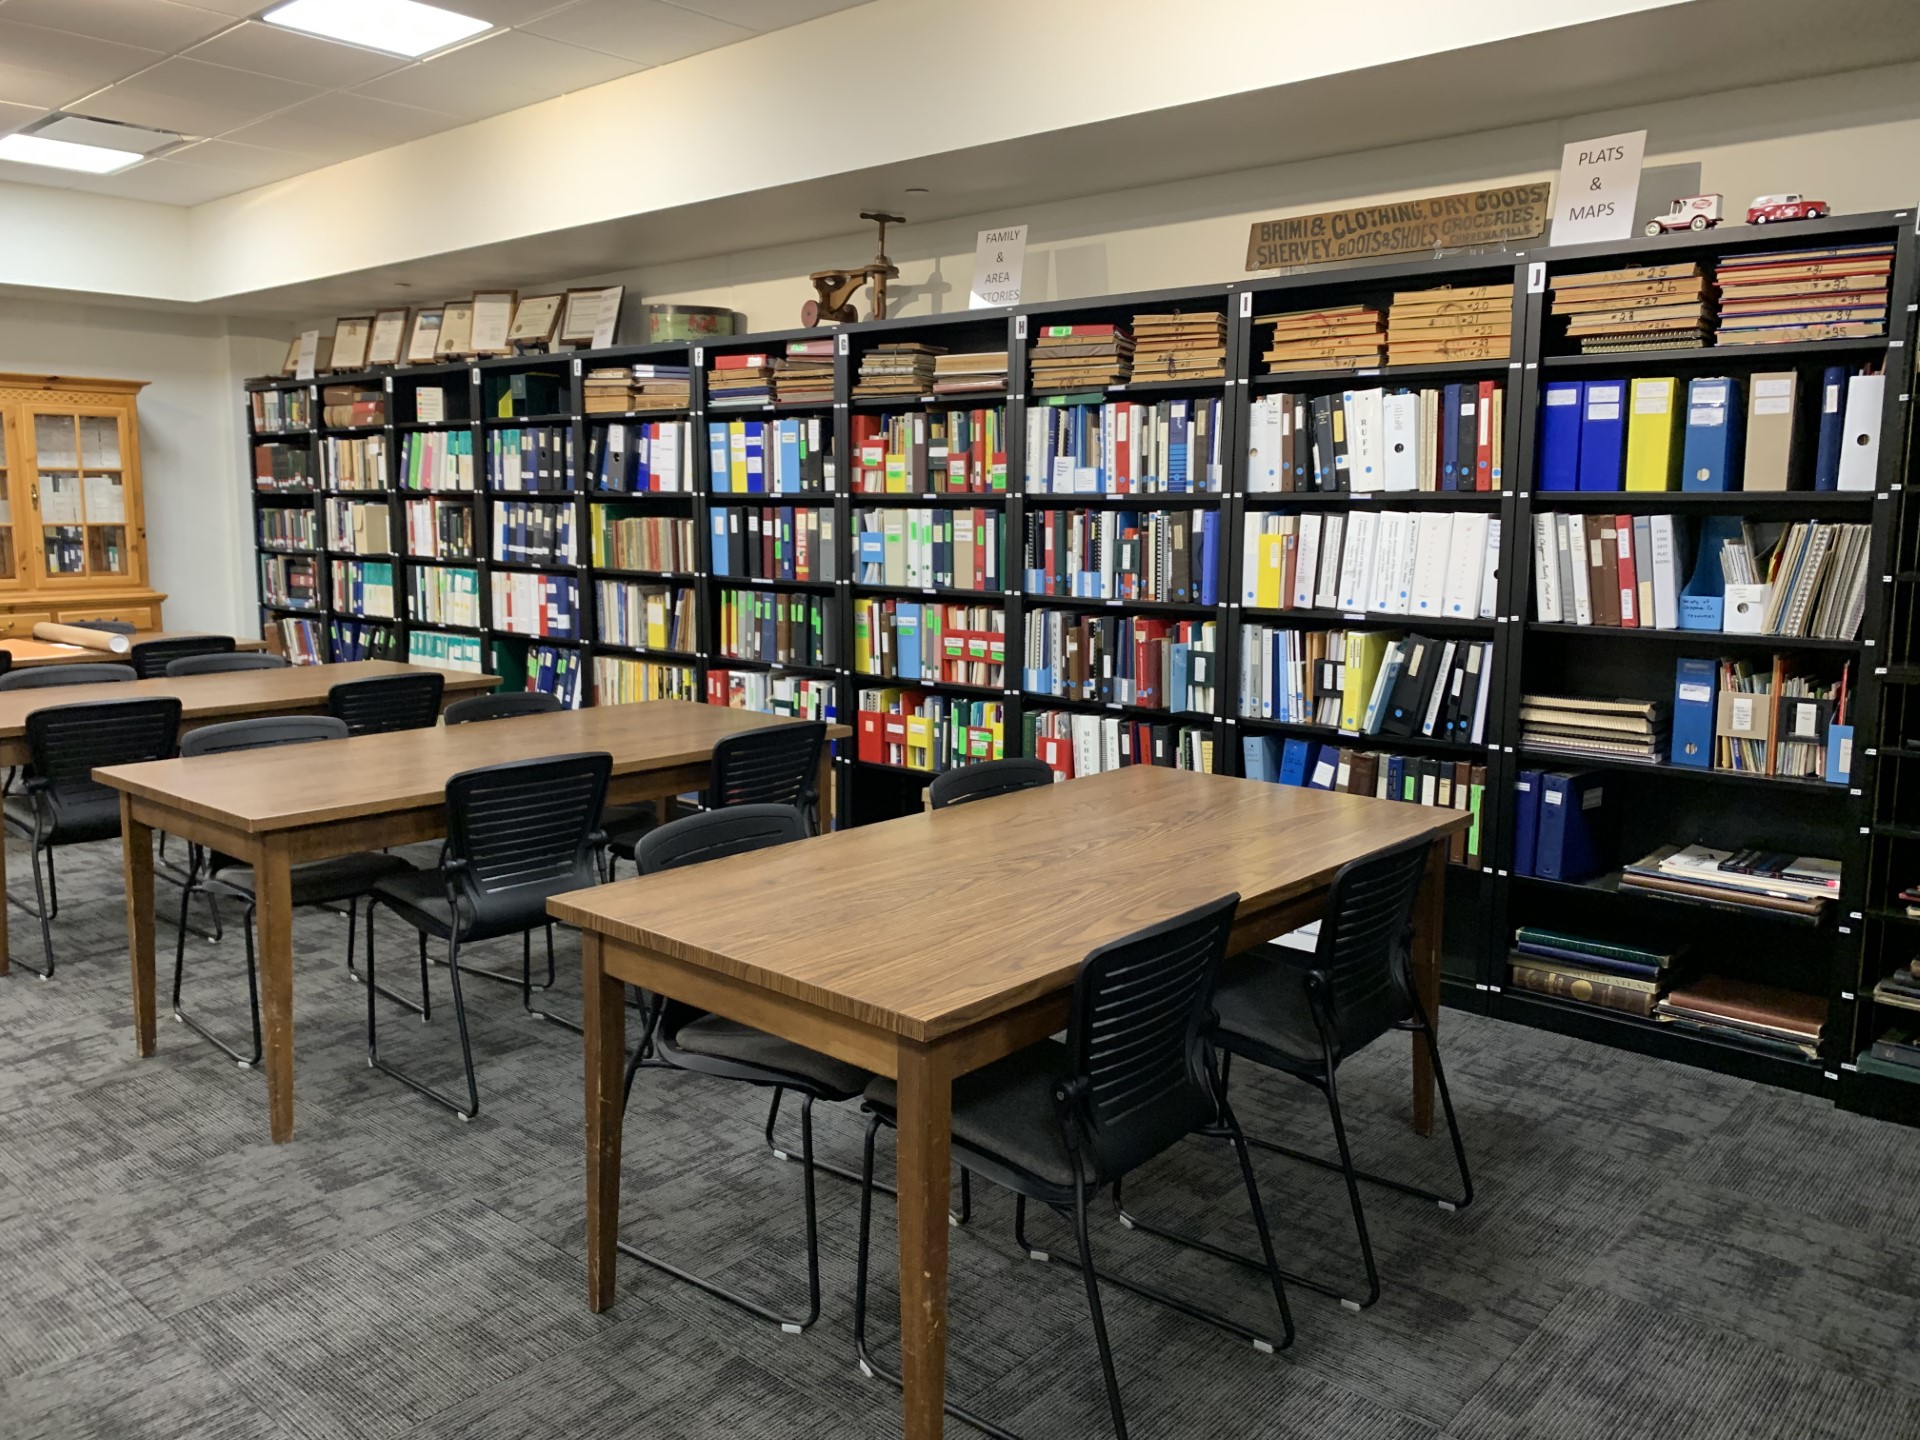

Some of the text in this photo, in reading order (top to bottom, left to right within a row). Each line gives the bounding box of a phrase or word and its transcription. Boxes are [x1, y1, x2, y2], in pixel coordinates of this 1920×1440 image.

[1578, 146, 1625, 166] PLATS
[1589, 176, 1602, 191] &
[1568, 202, 1616, 221] MAPS
[1260, 219, 1308, 243] BRIMI
[1310, 217, 1326, 237] &
[1430, 196, 1470, 218] DRY
[985, 229, 1021, 244] FAMILY
[996, 251, 1004, 263] &
[984, 271, 1011, 284] AREA
[1533, 268, 1541, 287] J
[1018, 320, 1025, 334] H
[840, 338, 847, 351] G
